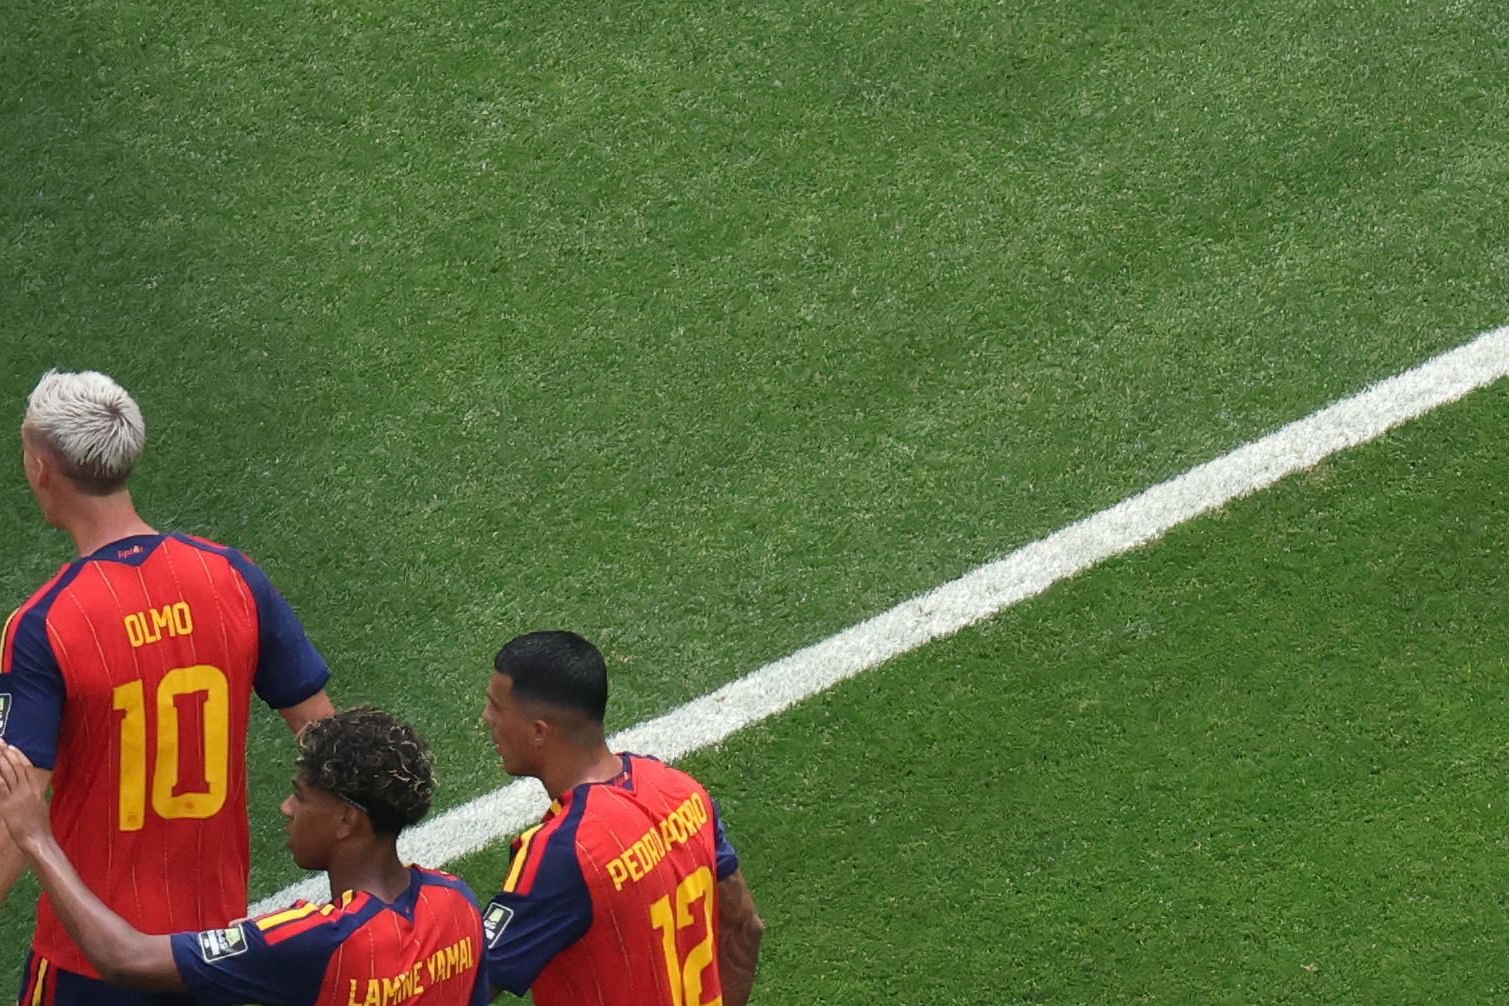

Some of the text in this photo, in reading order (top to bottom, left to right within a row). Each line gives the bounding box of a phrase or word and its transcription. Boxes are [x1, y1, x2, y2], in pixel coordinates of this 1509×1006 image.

[124, 601, 194, 647] OLMO
[113, 665, 230, 832] 10
[605, 827, 666, 891] PEDRO
